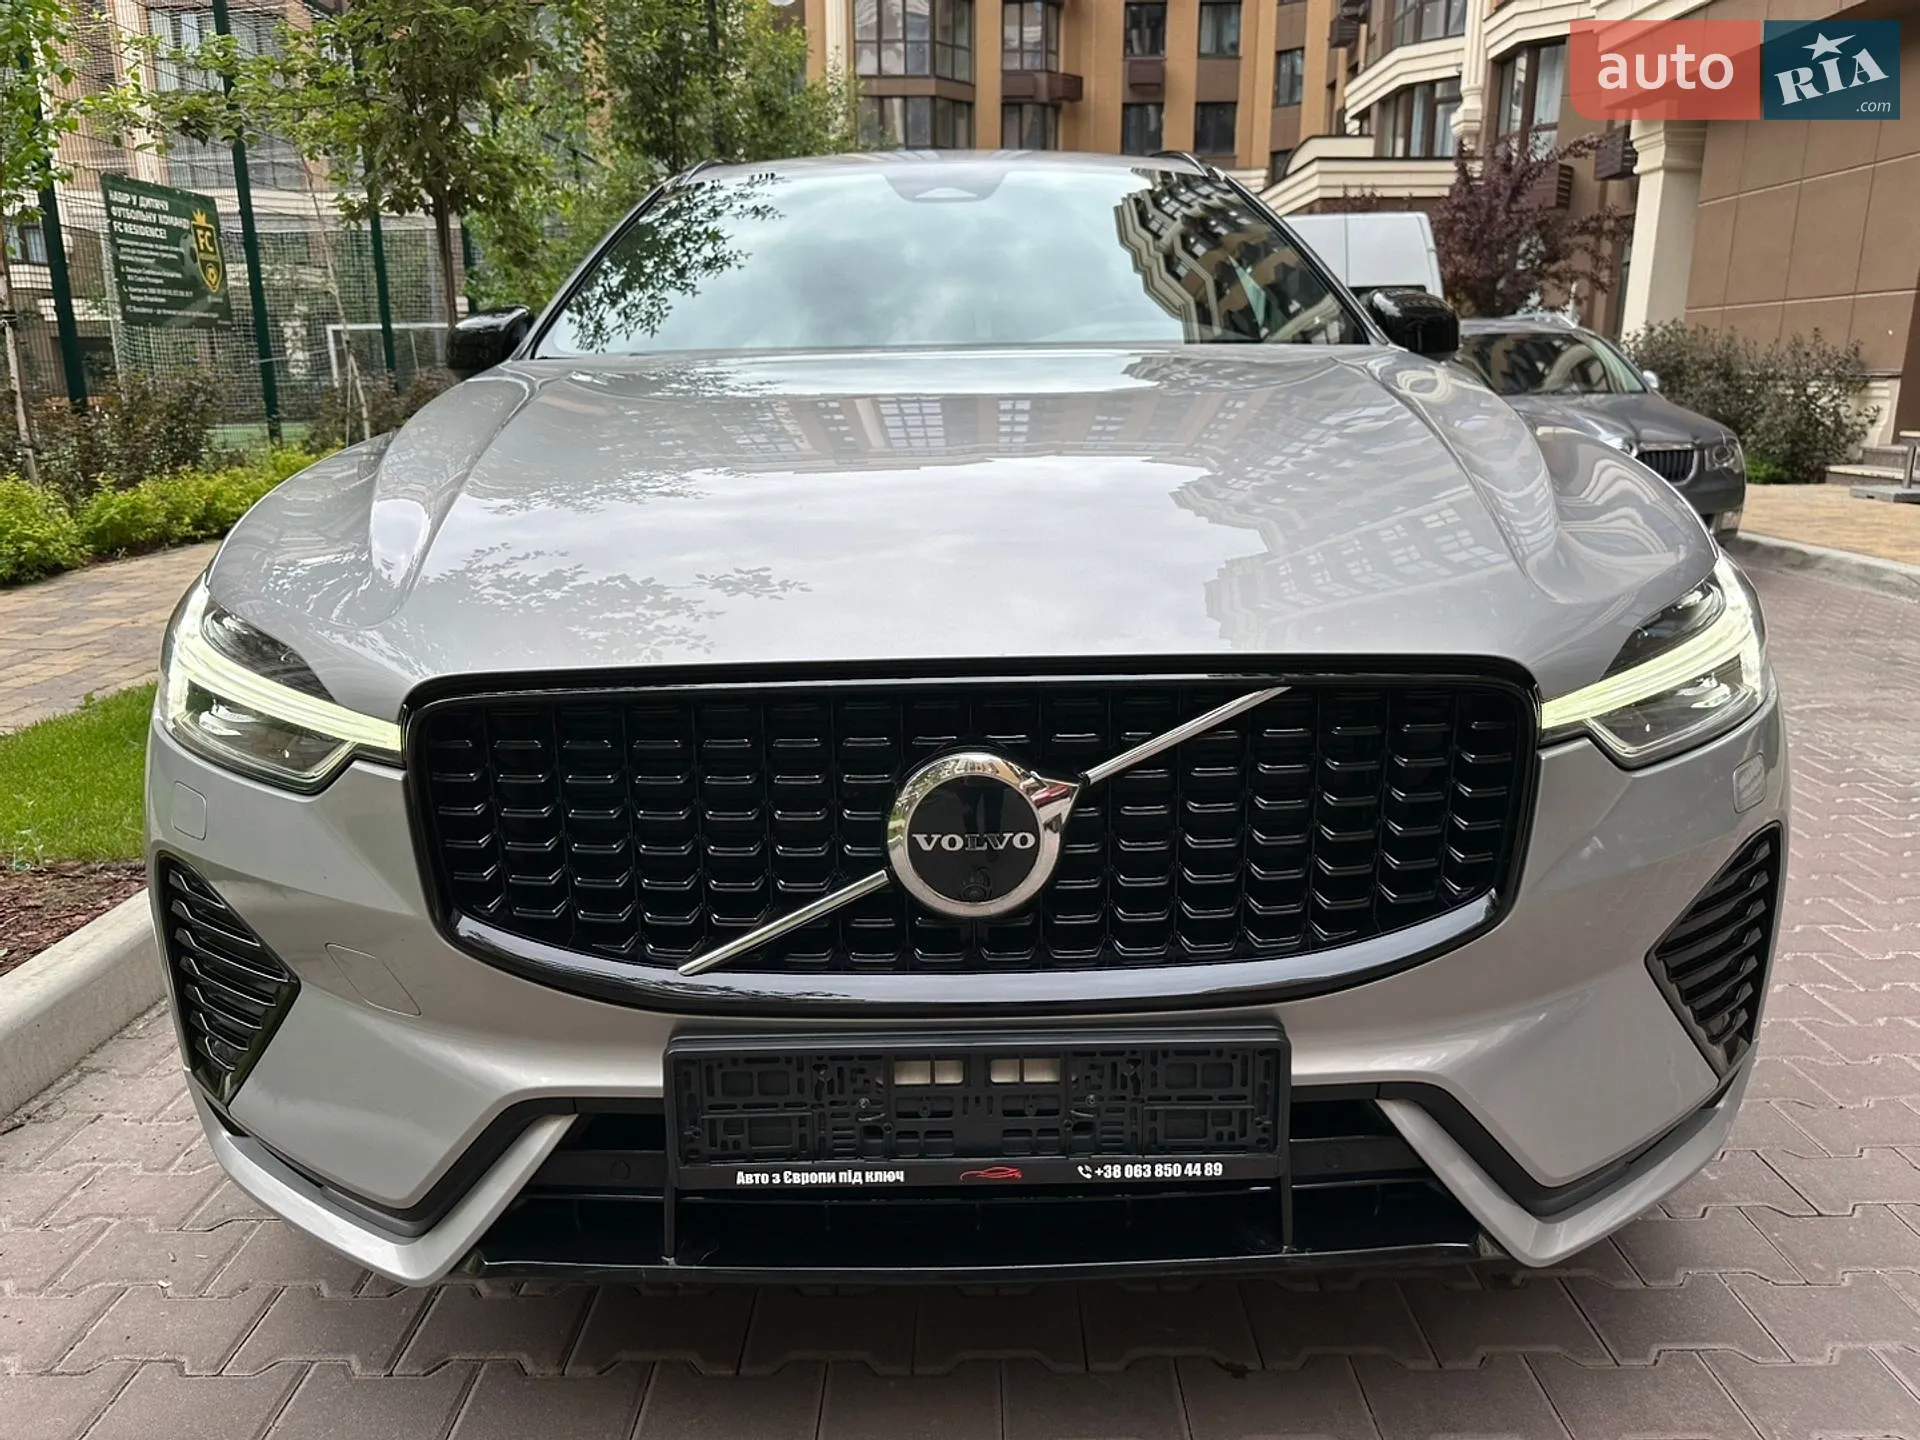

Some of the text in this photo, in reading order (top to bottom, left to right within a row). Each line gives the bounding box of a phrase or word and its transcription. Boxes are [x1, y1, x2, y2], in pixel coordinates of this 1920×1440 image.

[113, 221, 124, 233] FC
[197, 229, 214, 252] FC
[912, 832, 1036, 851] VOLVO
[736, 1169, 904, 1185] Авто з Європи під ключ
[1095, 1162, 1223, 1179] +38 063 850 44 89
